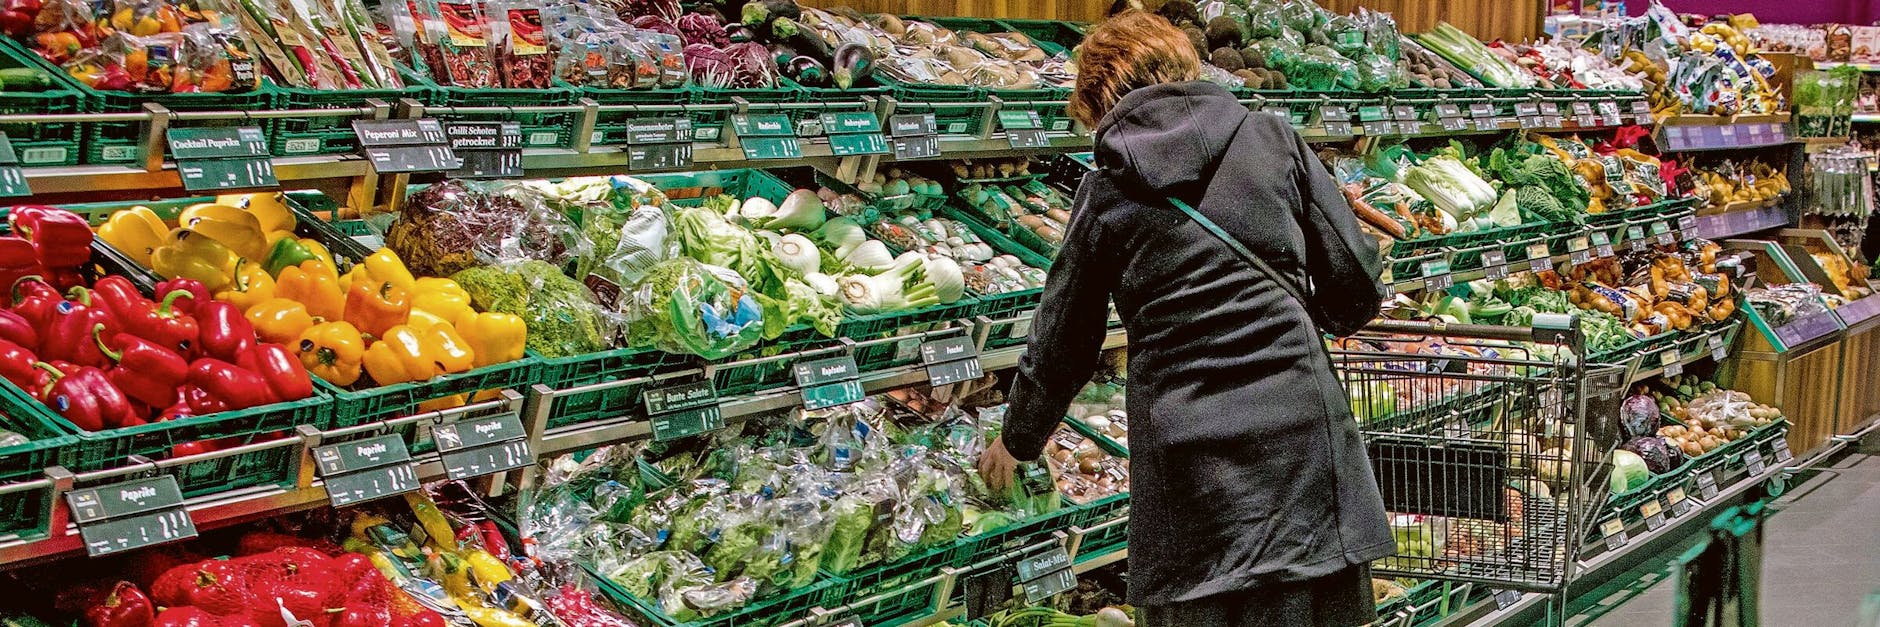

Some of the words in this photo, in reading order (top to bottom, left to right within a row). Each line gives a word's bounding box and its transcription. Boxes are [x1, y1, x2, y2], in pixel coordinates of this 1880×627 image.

[364, 129, 399, 140] Peperoni
[402, 129, 418, 138] Mix
[448, 126, 468, 135] Chilli
[468, 125, 497, 135] Schoten
[173, 139, 207, 150] Cocktail
[207, 138, 240, 149] Paprika
[452, 137, 496, 148] getrocknet
[666, 392, 686, 403] Bunte
[687, 388, 709, 399] Salate
[475, 421, 502, 434] Paprika
[357, 443, 387, 457] Paprika
[121, 486, 157, 502] Paprika
[1033, 553, 1067, 571] Salat-Mix
